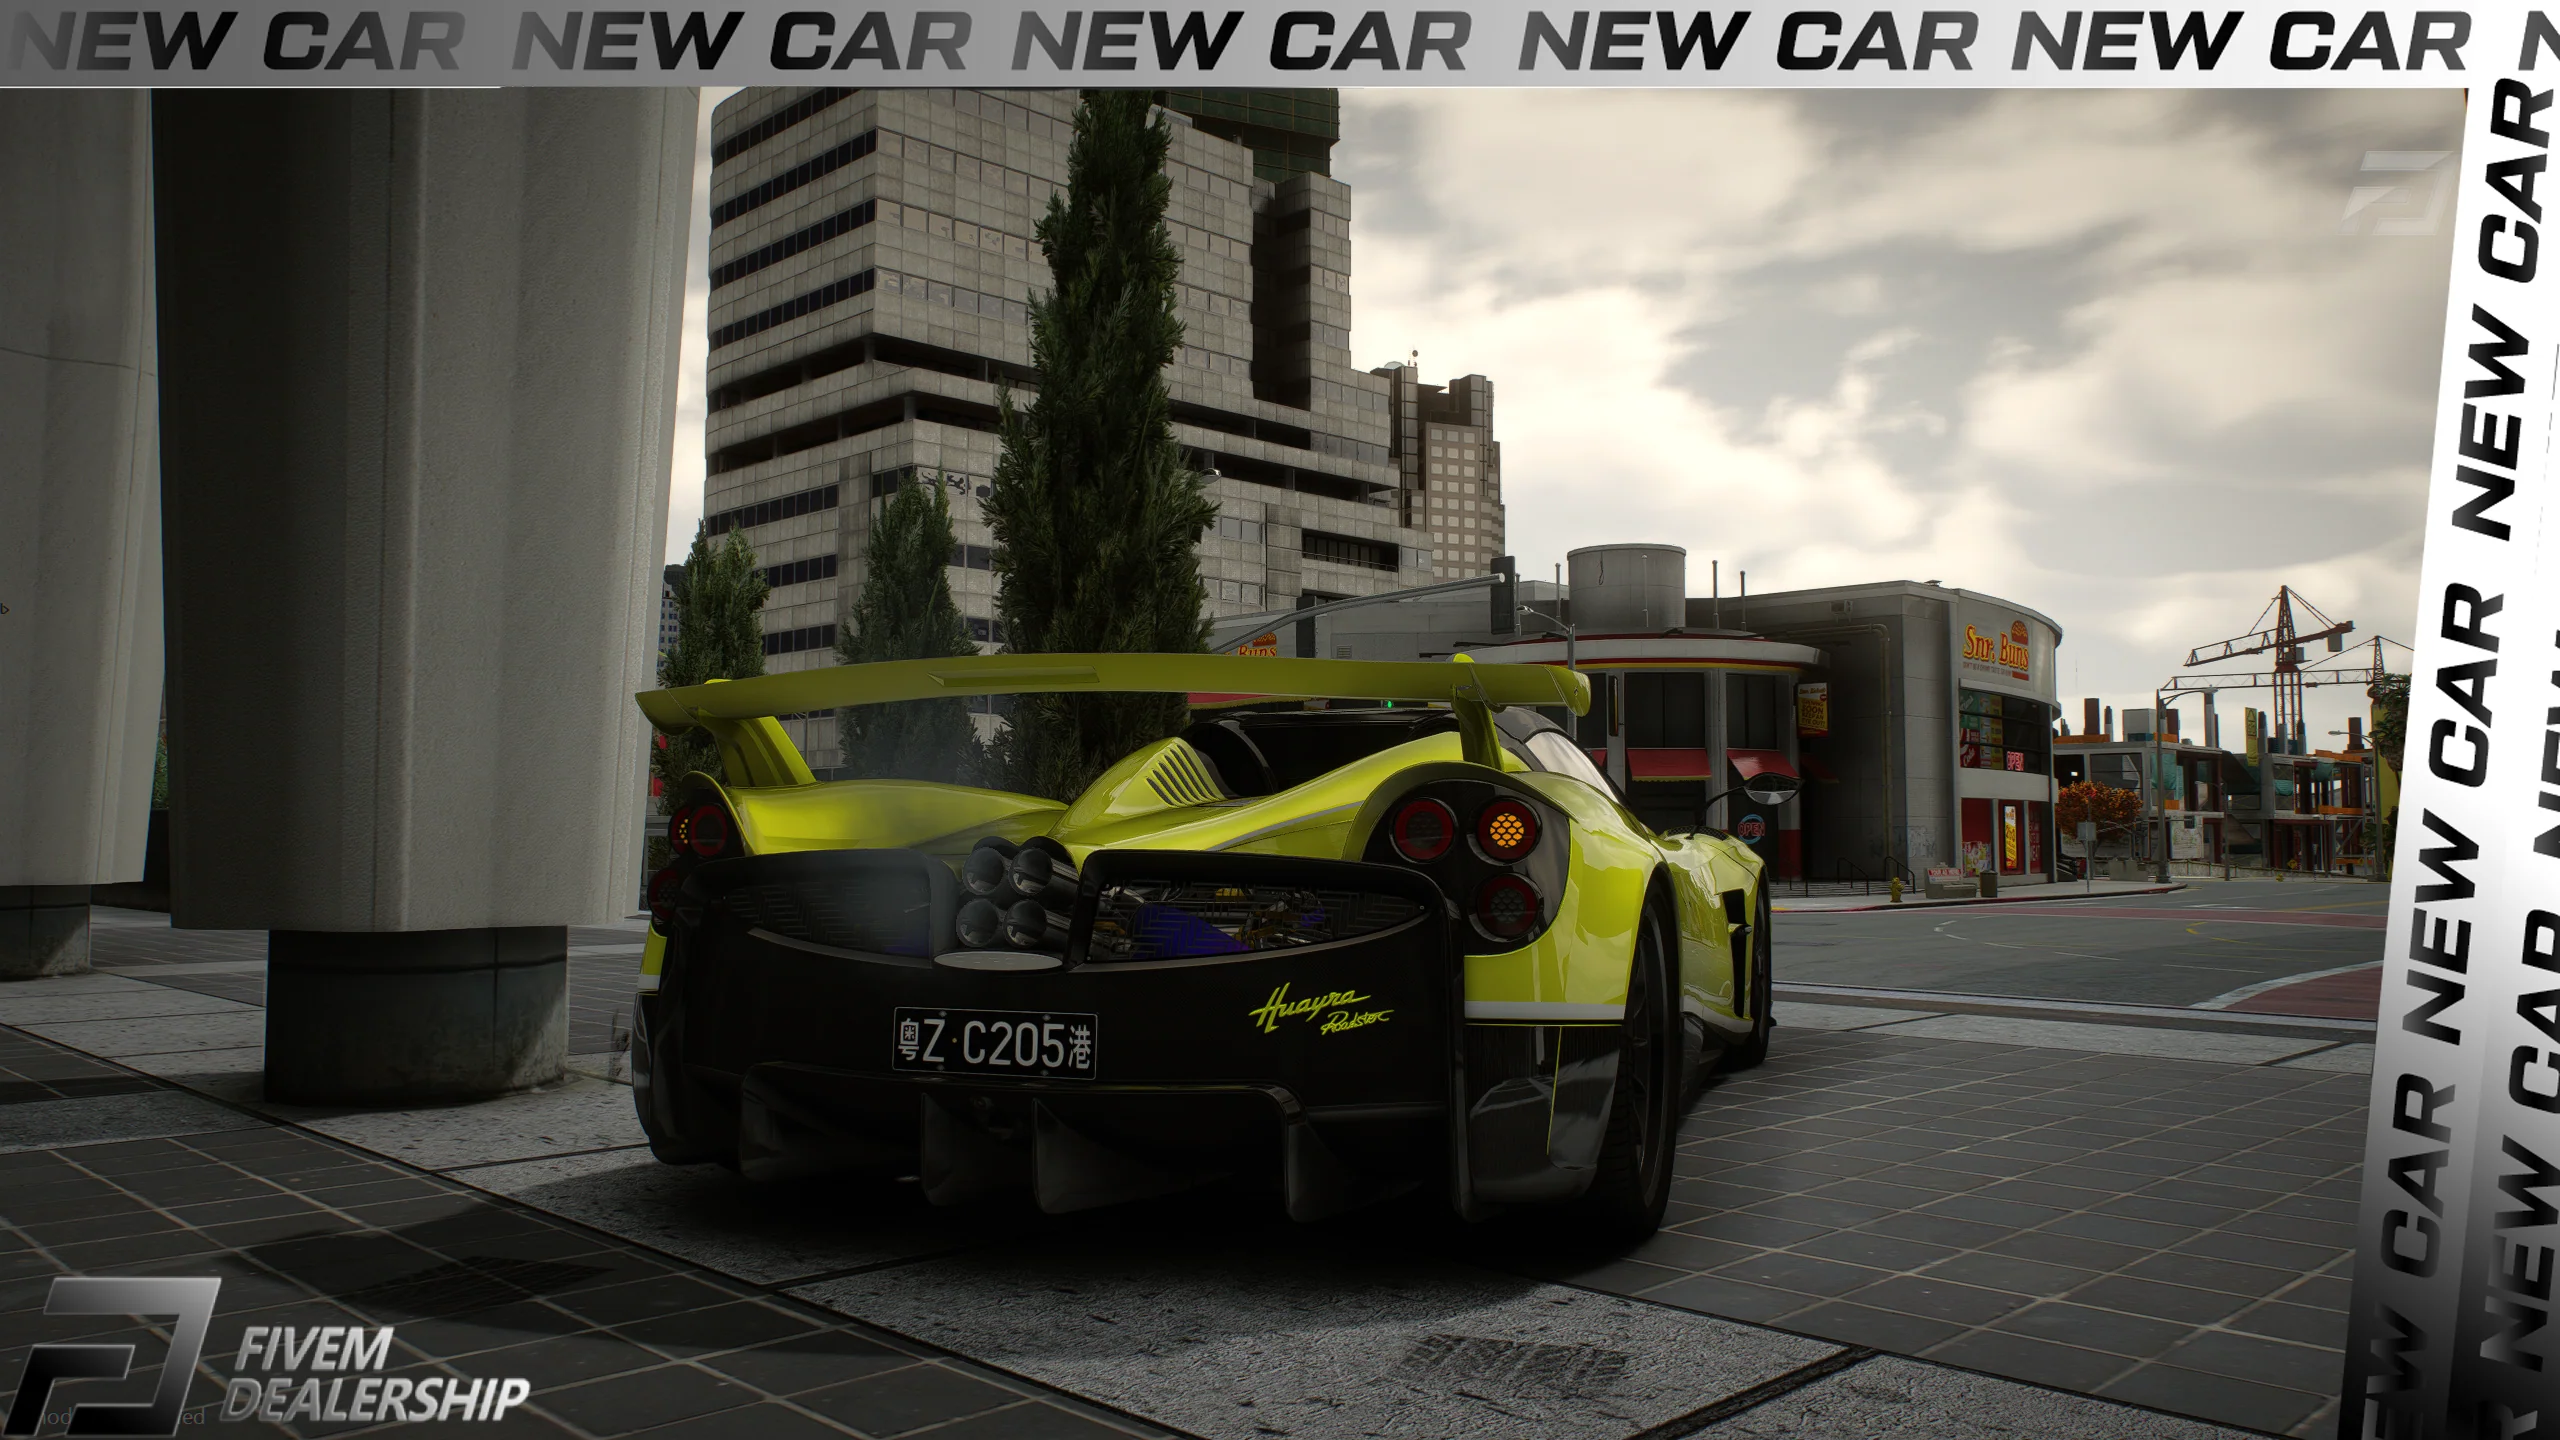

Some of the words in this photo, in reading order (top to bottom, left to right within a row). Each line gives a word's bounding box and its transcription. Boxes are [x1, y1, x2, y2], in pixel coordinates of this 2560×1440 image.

[1963, 623, 1996, 663] Snr.
[1998, 631, 2029, 671] Buns
[1801, 705, 1823, 714] SOON
[2007, 750, 2024, 772] OPEN
[1738, 822, 1765, 836] OPEN
[1248, 982, 1371, 1034] Huayra
[1320, 1010, 1394, 1035] Roadster
